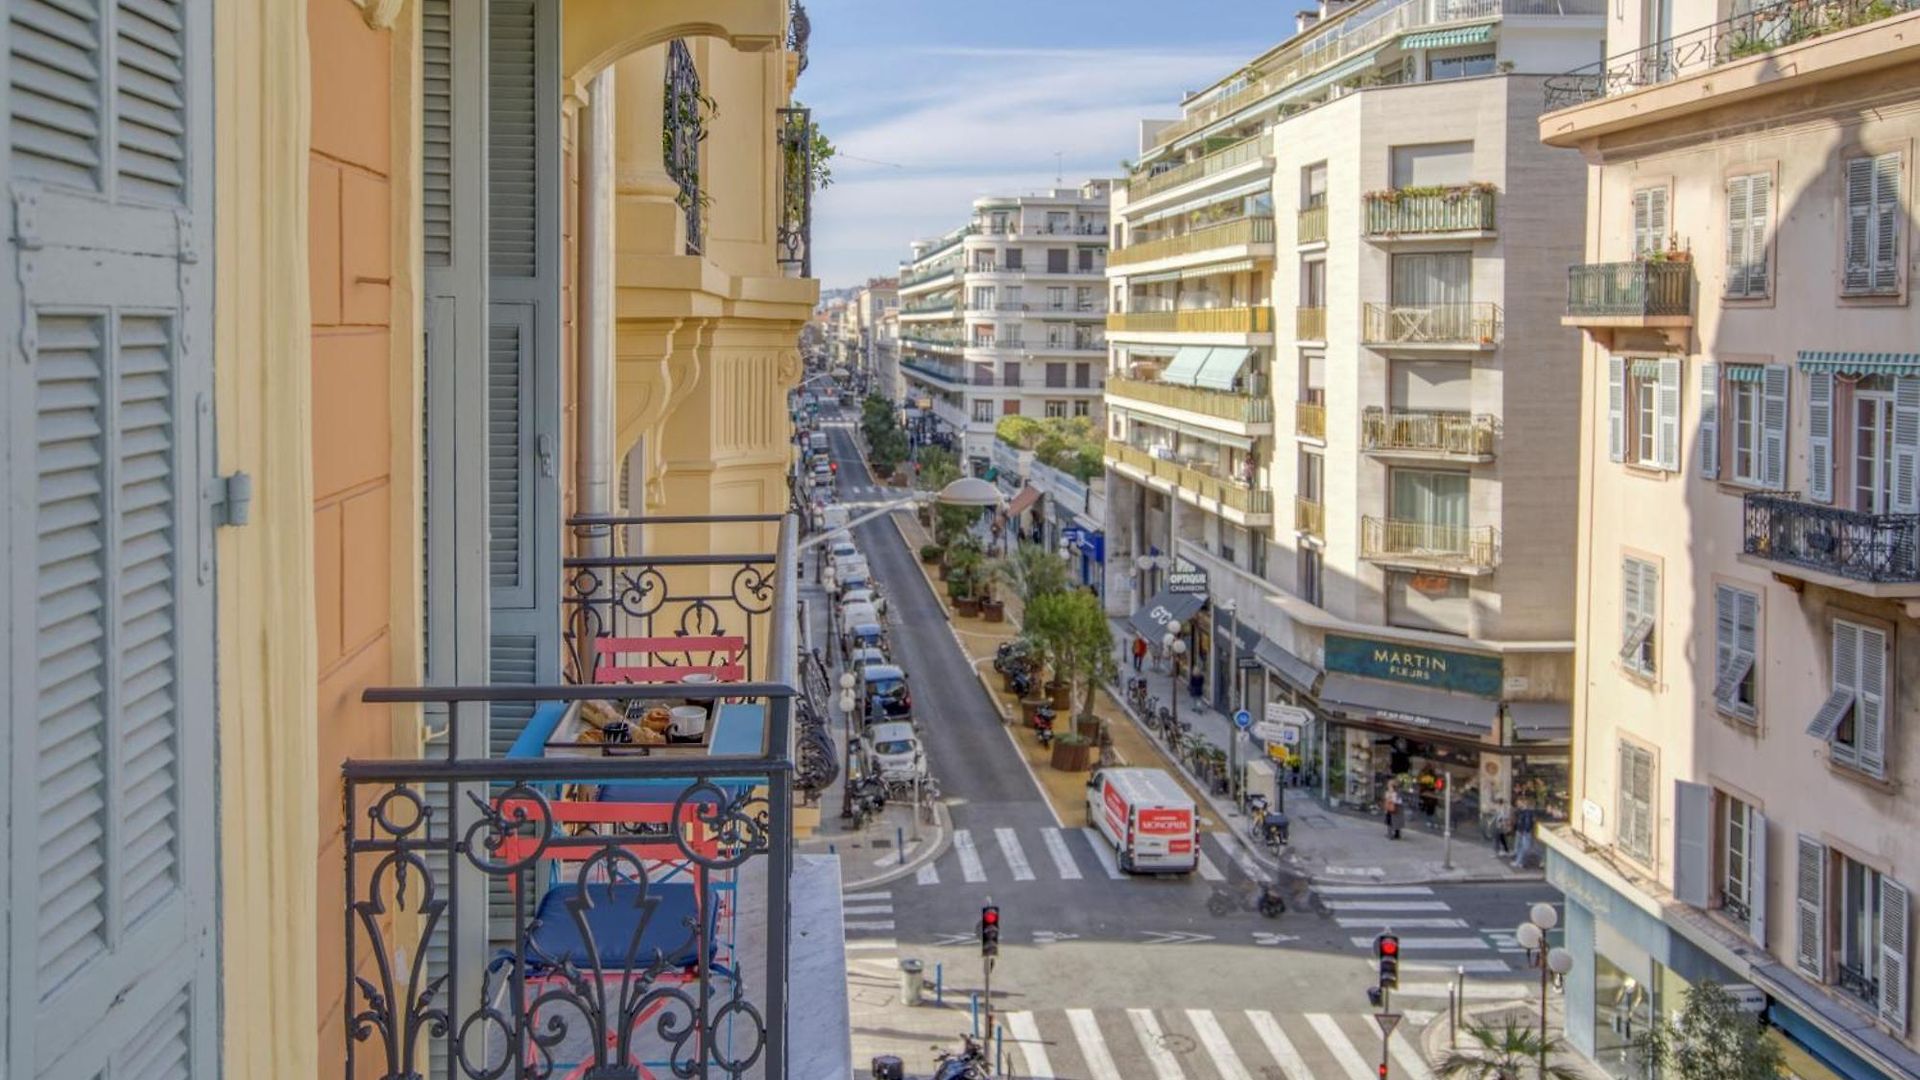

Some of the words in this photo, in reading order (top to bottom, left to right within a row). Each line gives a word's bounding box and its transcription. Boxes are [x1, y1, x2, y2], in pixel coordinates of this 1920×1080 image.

[1170, 573, 1206, 584] OPTIQUE
[1374, 649, 1447, 672] MARTIN
[1389, 665, 1431, 680] FLEURS
[1141, 821, 1188, 830] MONOPRIX
